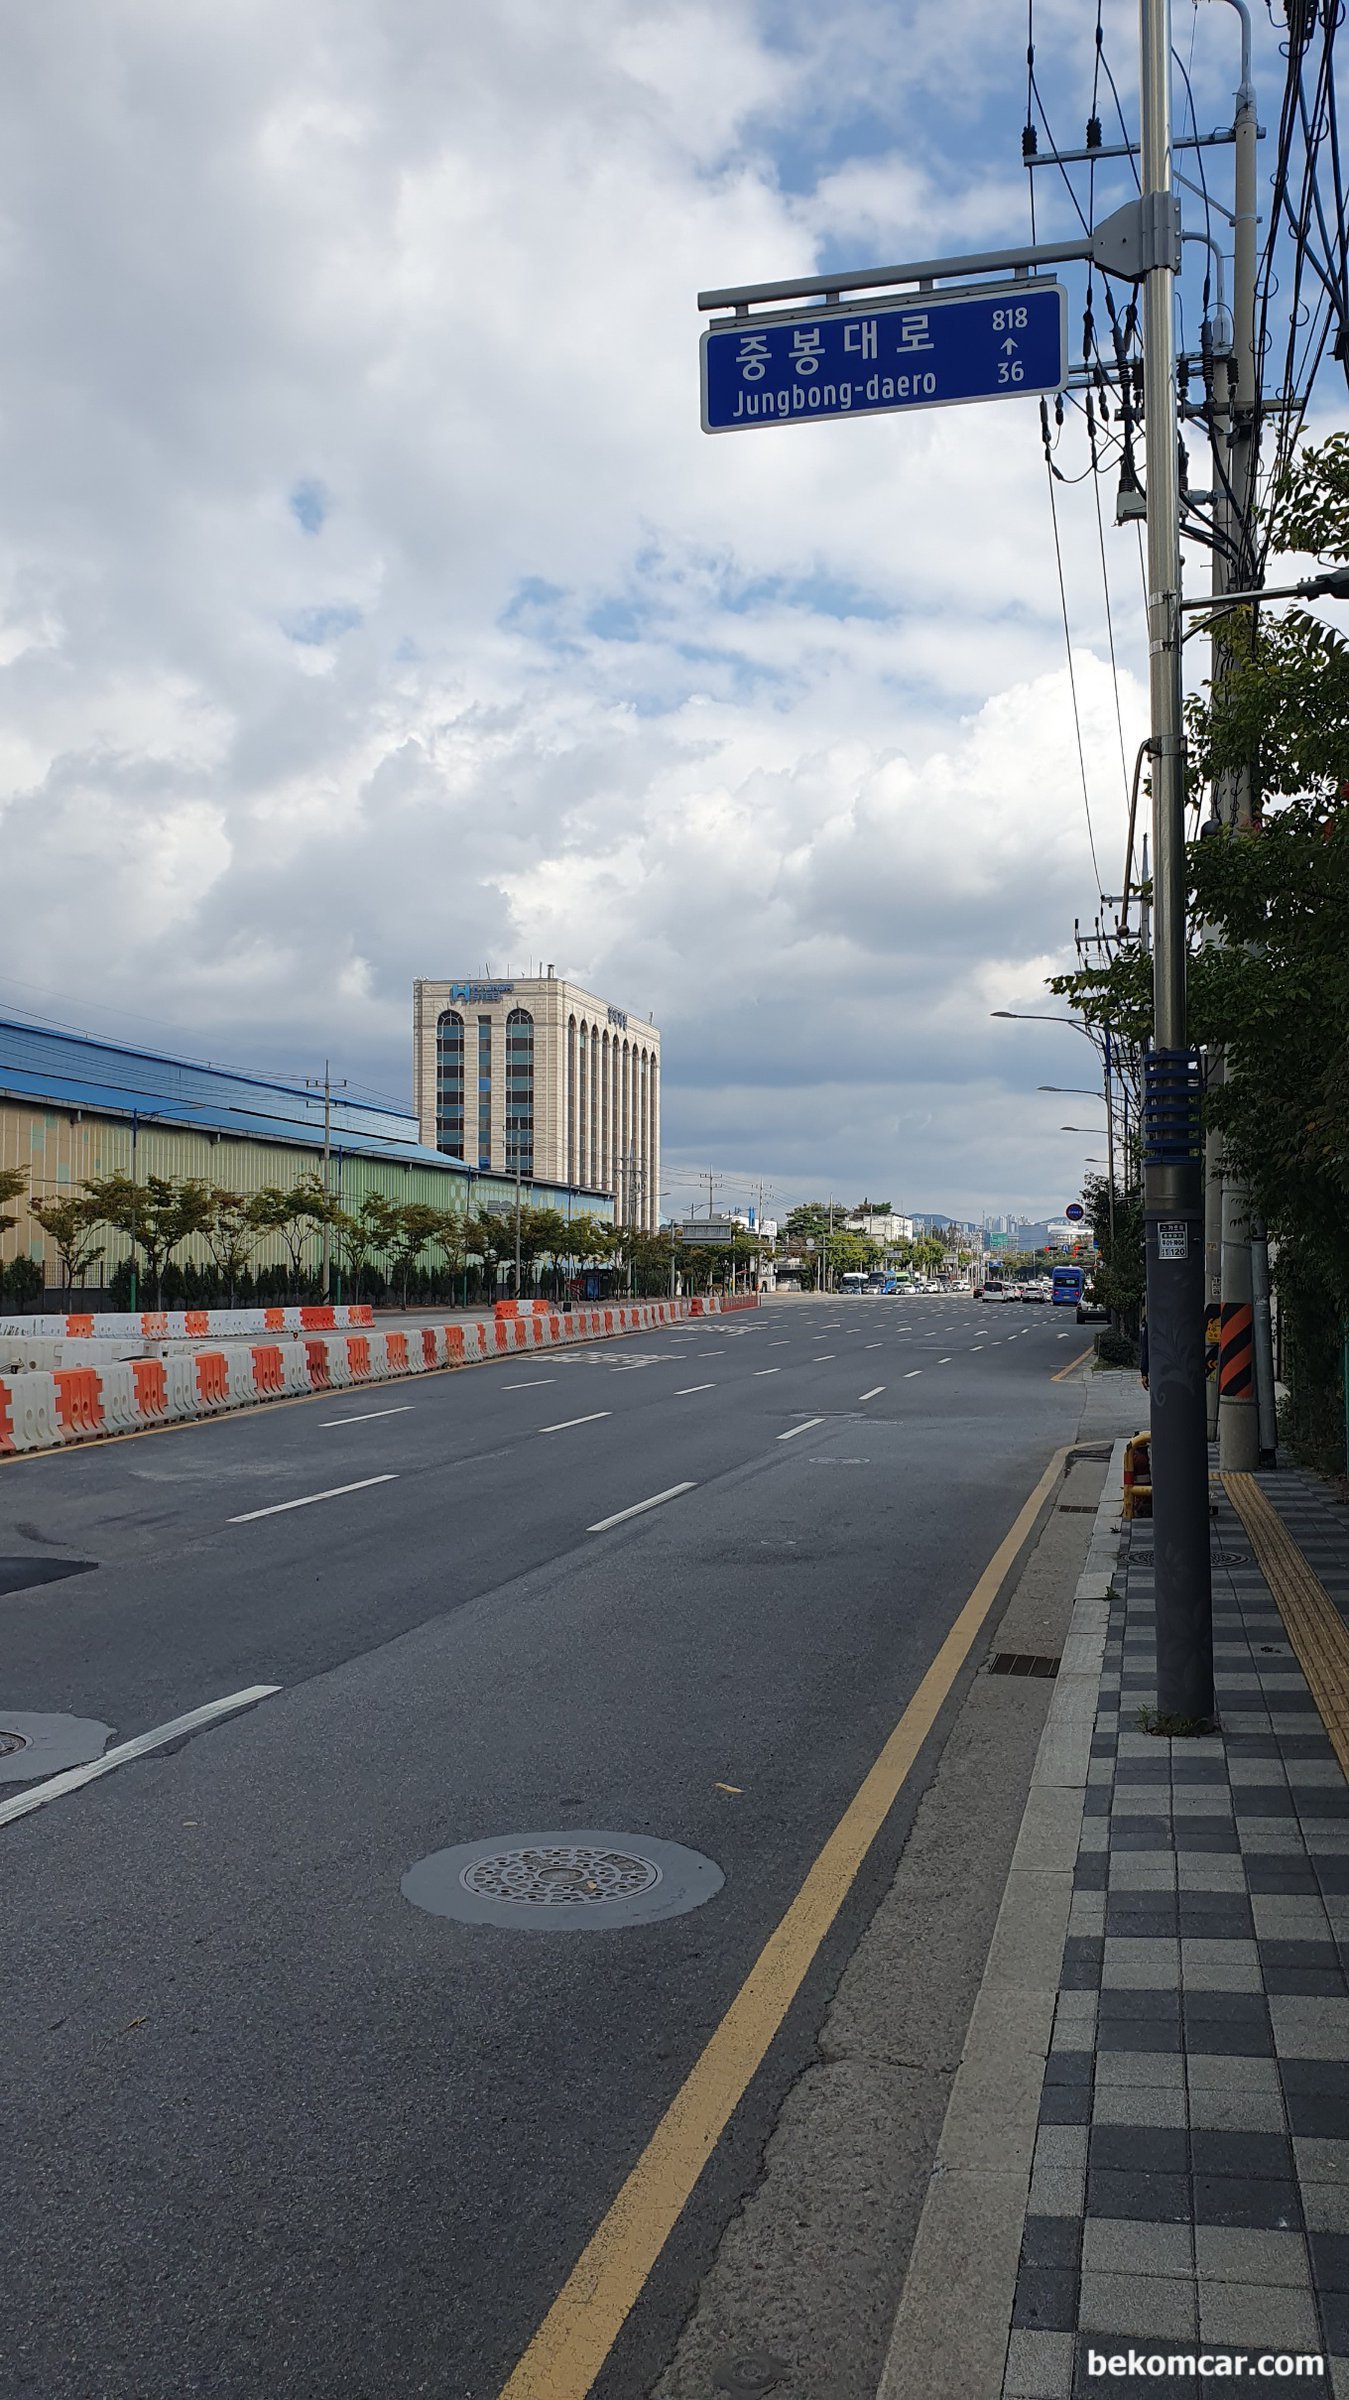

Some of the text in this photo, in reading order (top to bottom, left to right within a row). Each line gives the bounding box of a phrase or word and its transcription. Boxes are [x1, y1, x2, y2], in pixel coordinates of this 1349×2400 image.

[992, 307, 1028, 331] 818
[735, 314, 935, 381] 중봉대로
[997, 360, 1025, 384] 36
[733, 372, 937, 417] Jungbong-daero
[1170, 1248, 1185, 1256] 120
